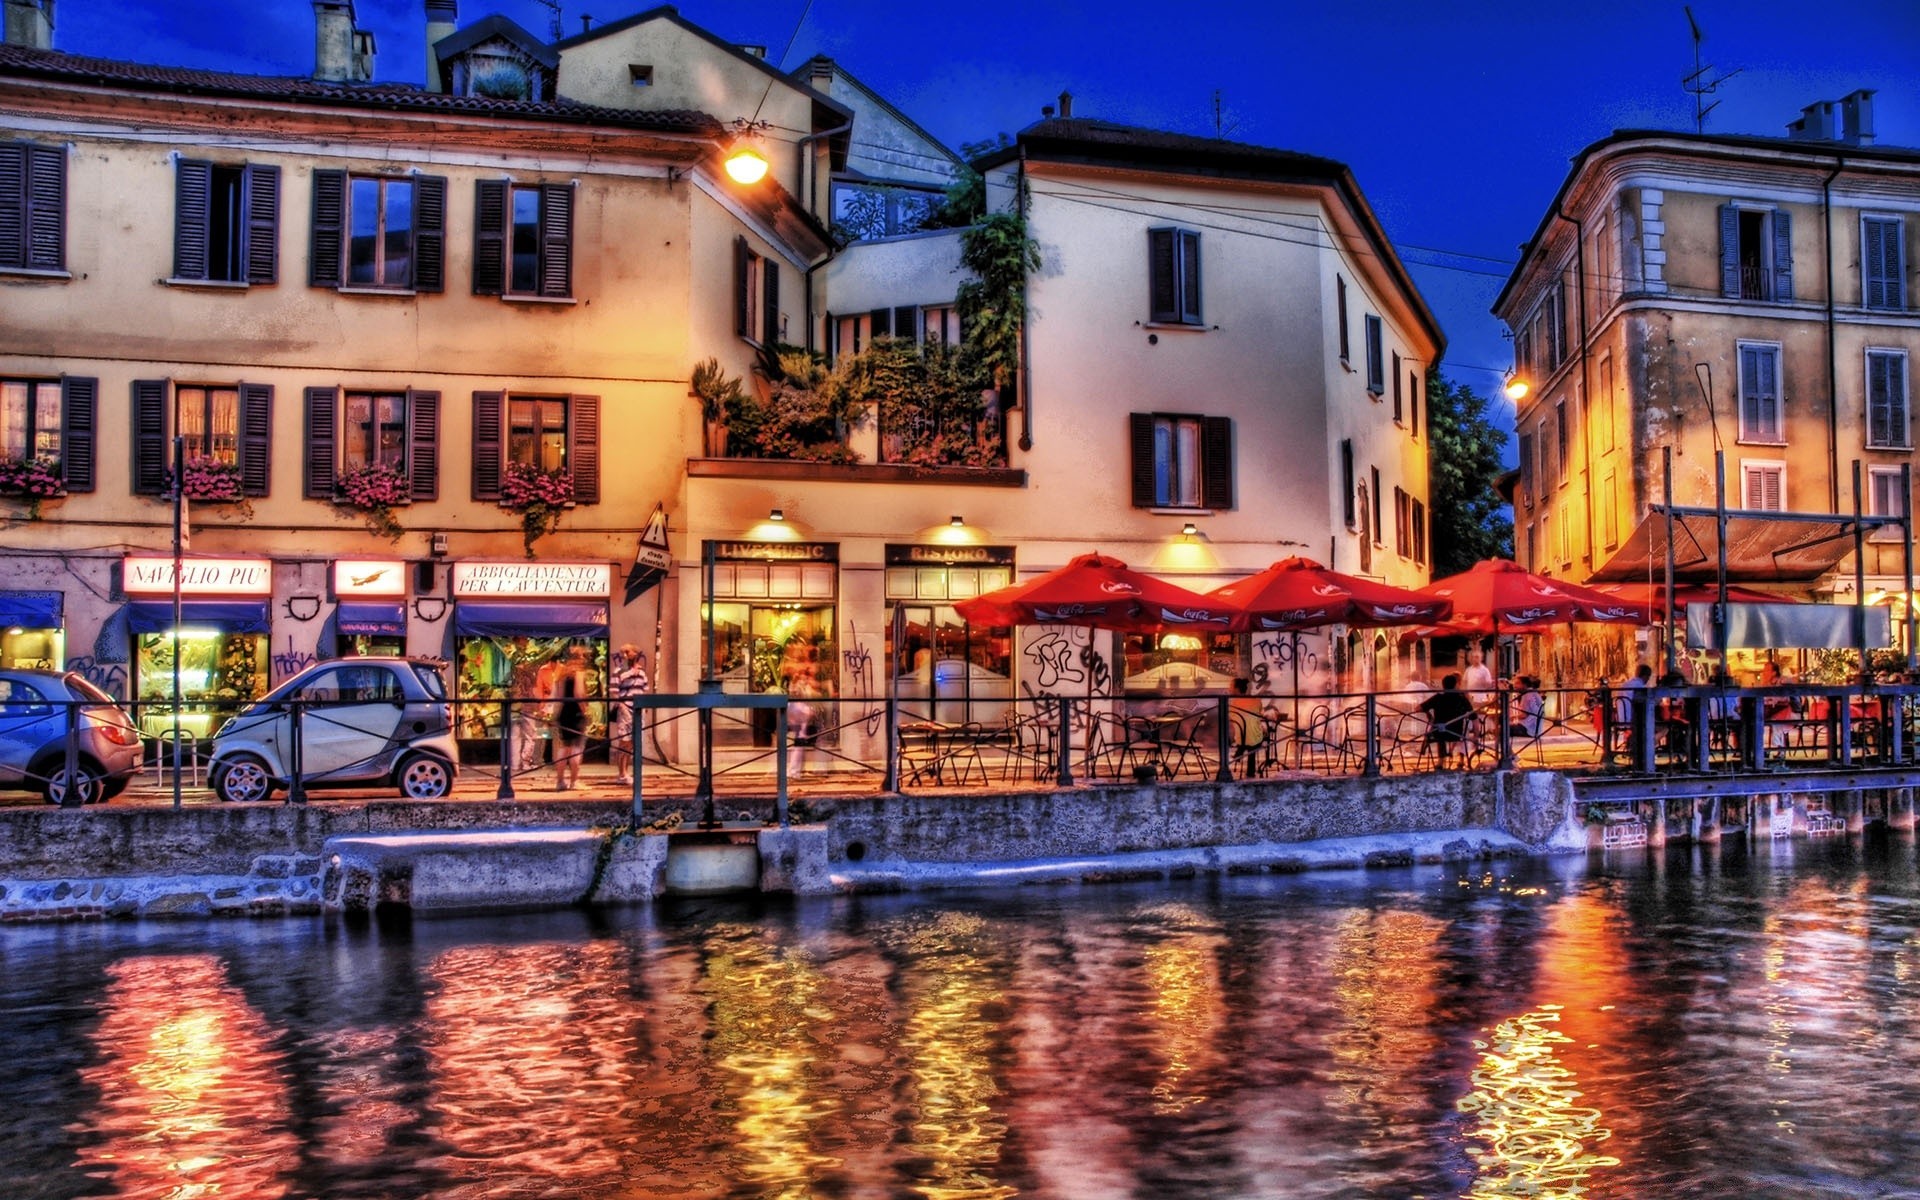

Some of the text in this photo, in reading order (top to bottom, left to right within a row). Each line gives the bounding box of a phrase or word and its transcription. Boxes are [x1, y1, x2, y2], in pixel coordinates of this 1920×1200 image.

[130, 564, 220, 585] NAVIGLIO
[467, 565, 597, 579] ABBIGLIAMENTO
[459, 579, 487, 592] PER
